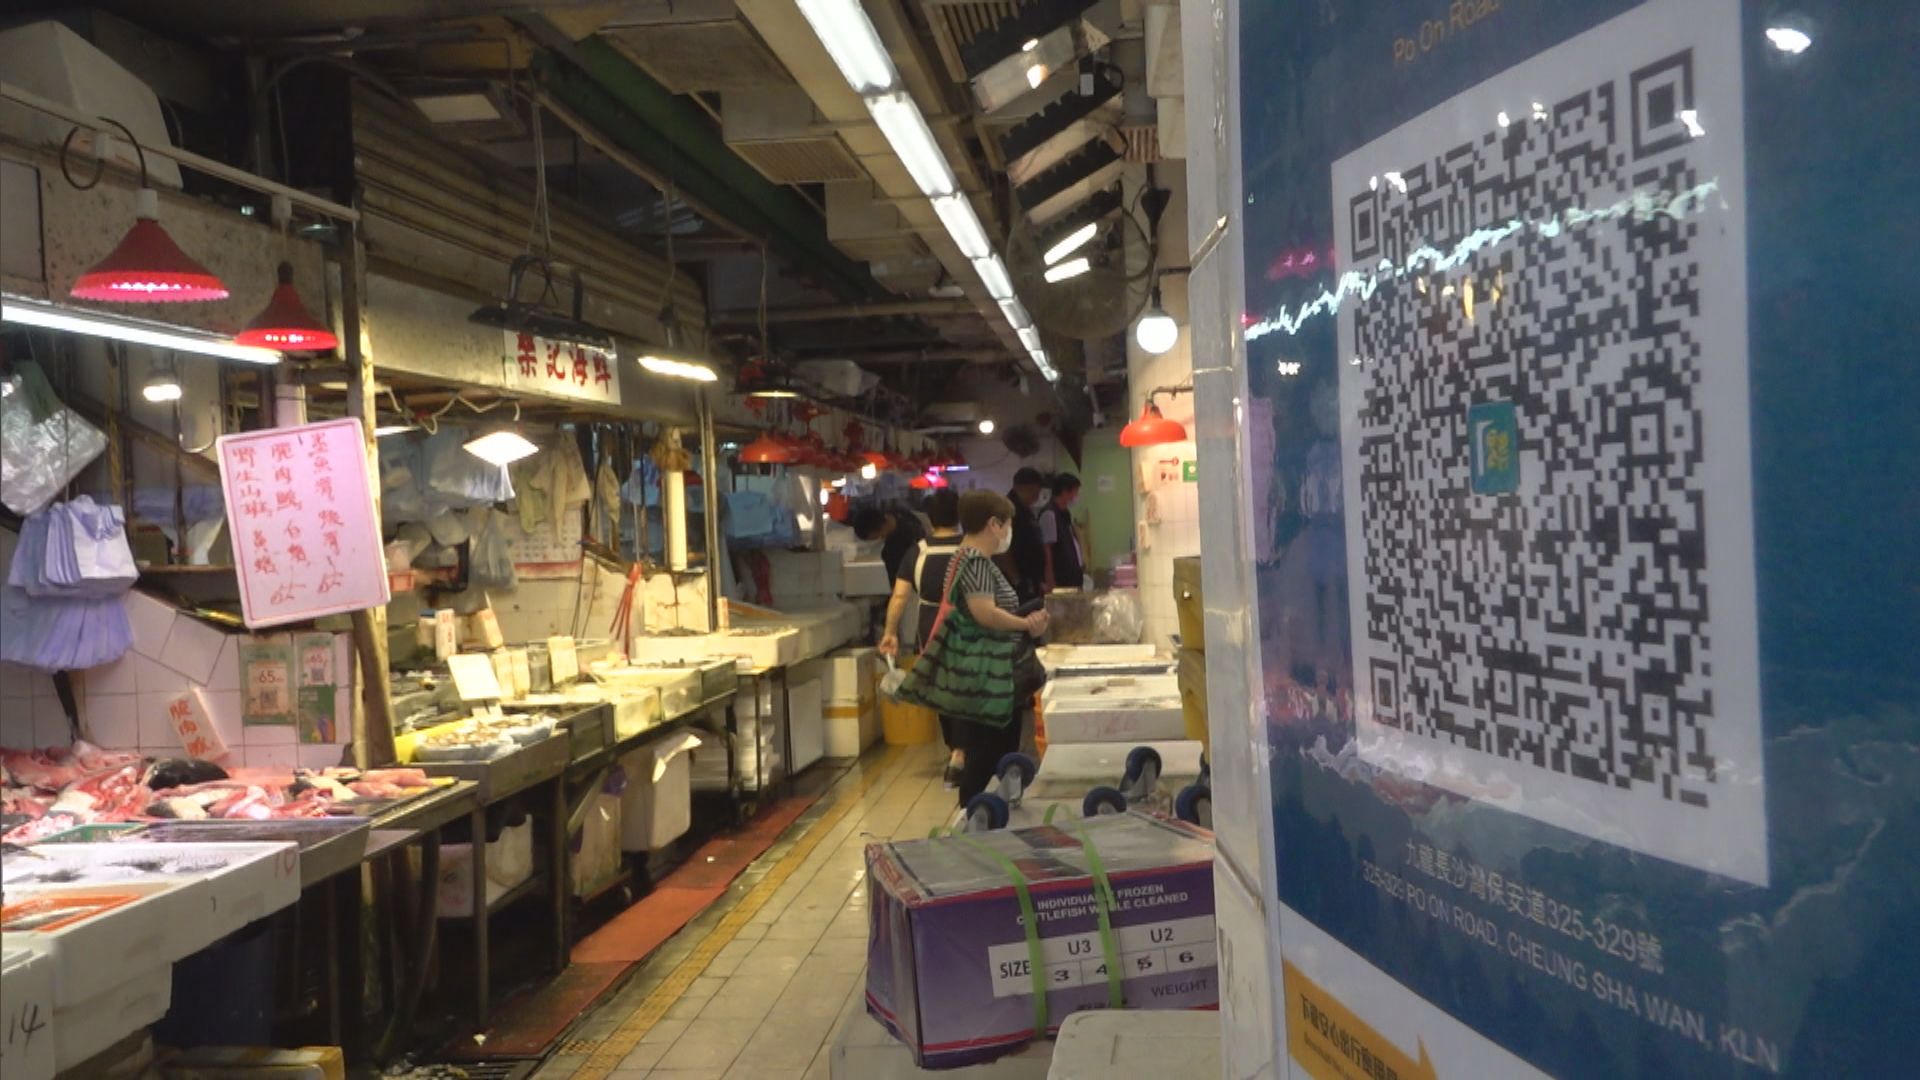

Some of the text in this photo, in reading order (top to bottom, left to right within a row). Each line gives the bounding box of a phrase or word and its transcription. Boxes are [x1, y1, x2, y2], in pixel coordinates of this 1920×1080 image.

[1393, 37, 1416, 67] Po
[1420, 20, 1445, 52] On
[1016, 892, 1188, 926] CTTLEFISH WLE CLEANED
[1037, 884, 1164, 910] INDIVIDUA FROZEN
[1068, 939, 1092, 956] U3
[1150, 927, 1174, 944] U2
[1000, 959, 1032, 980] SIZE
[1055, 969, 1070, 982] 3
[1095, 963, 1108, 976] 4
[1178, 951, 1194, 964] 6
[1407, 883, 1426, 912] PO
[1428, 894, 1449, 924] ON
[1507, 930, 1588, 992] CHEUNG
[1592, 971, 1640, 1017] SHA
[1719, 1023, 1779, 1073] KLN
[1151, 978, 1208, 998] WEIGHT
[9, 1002, 46, 1048] 14
